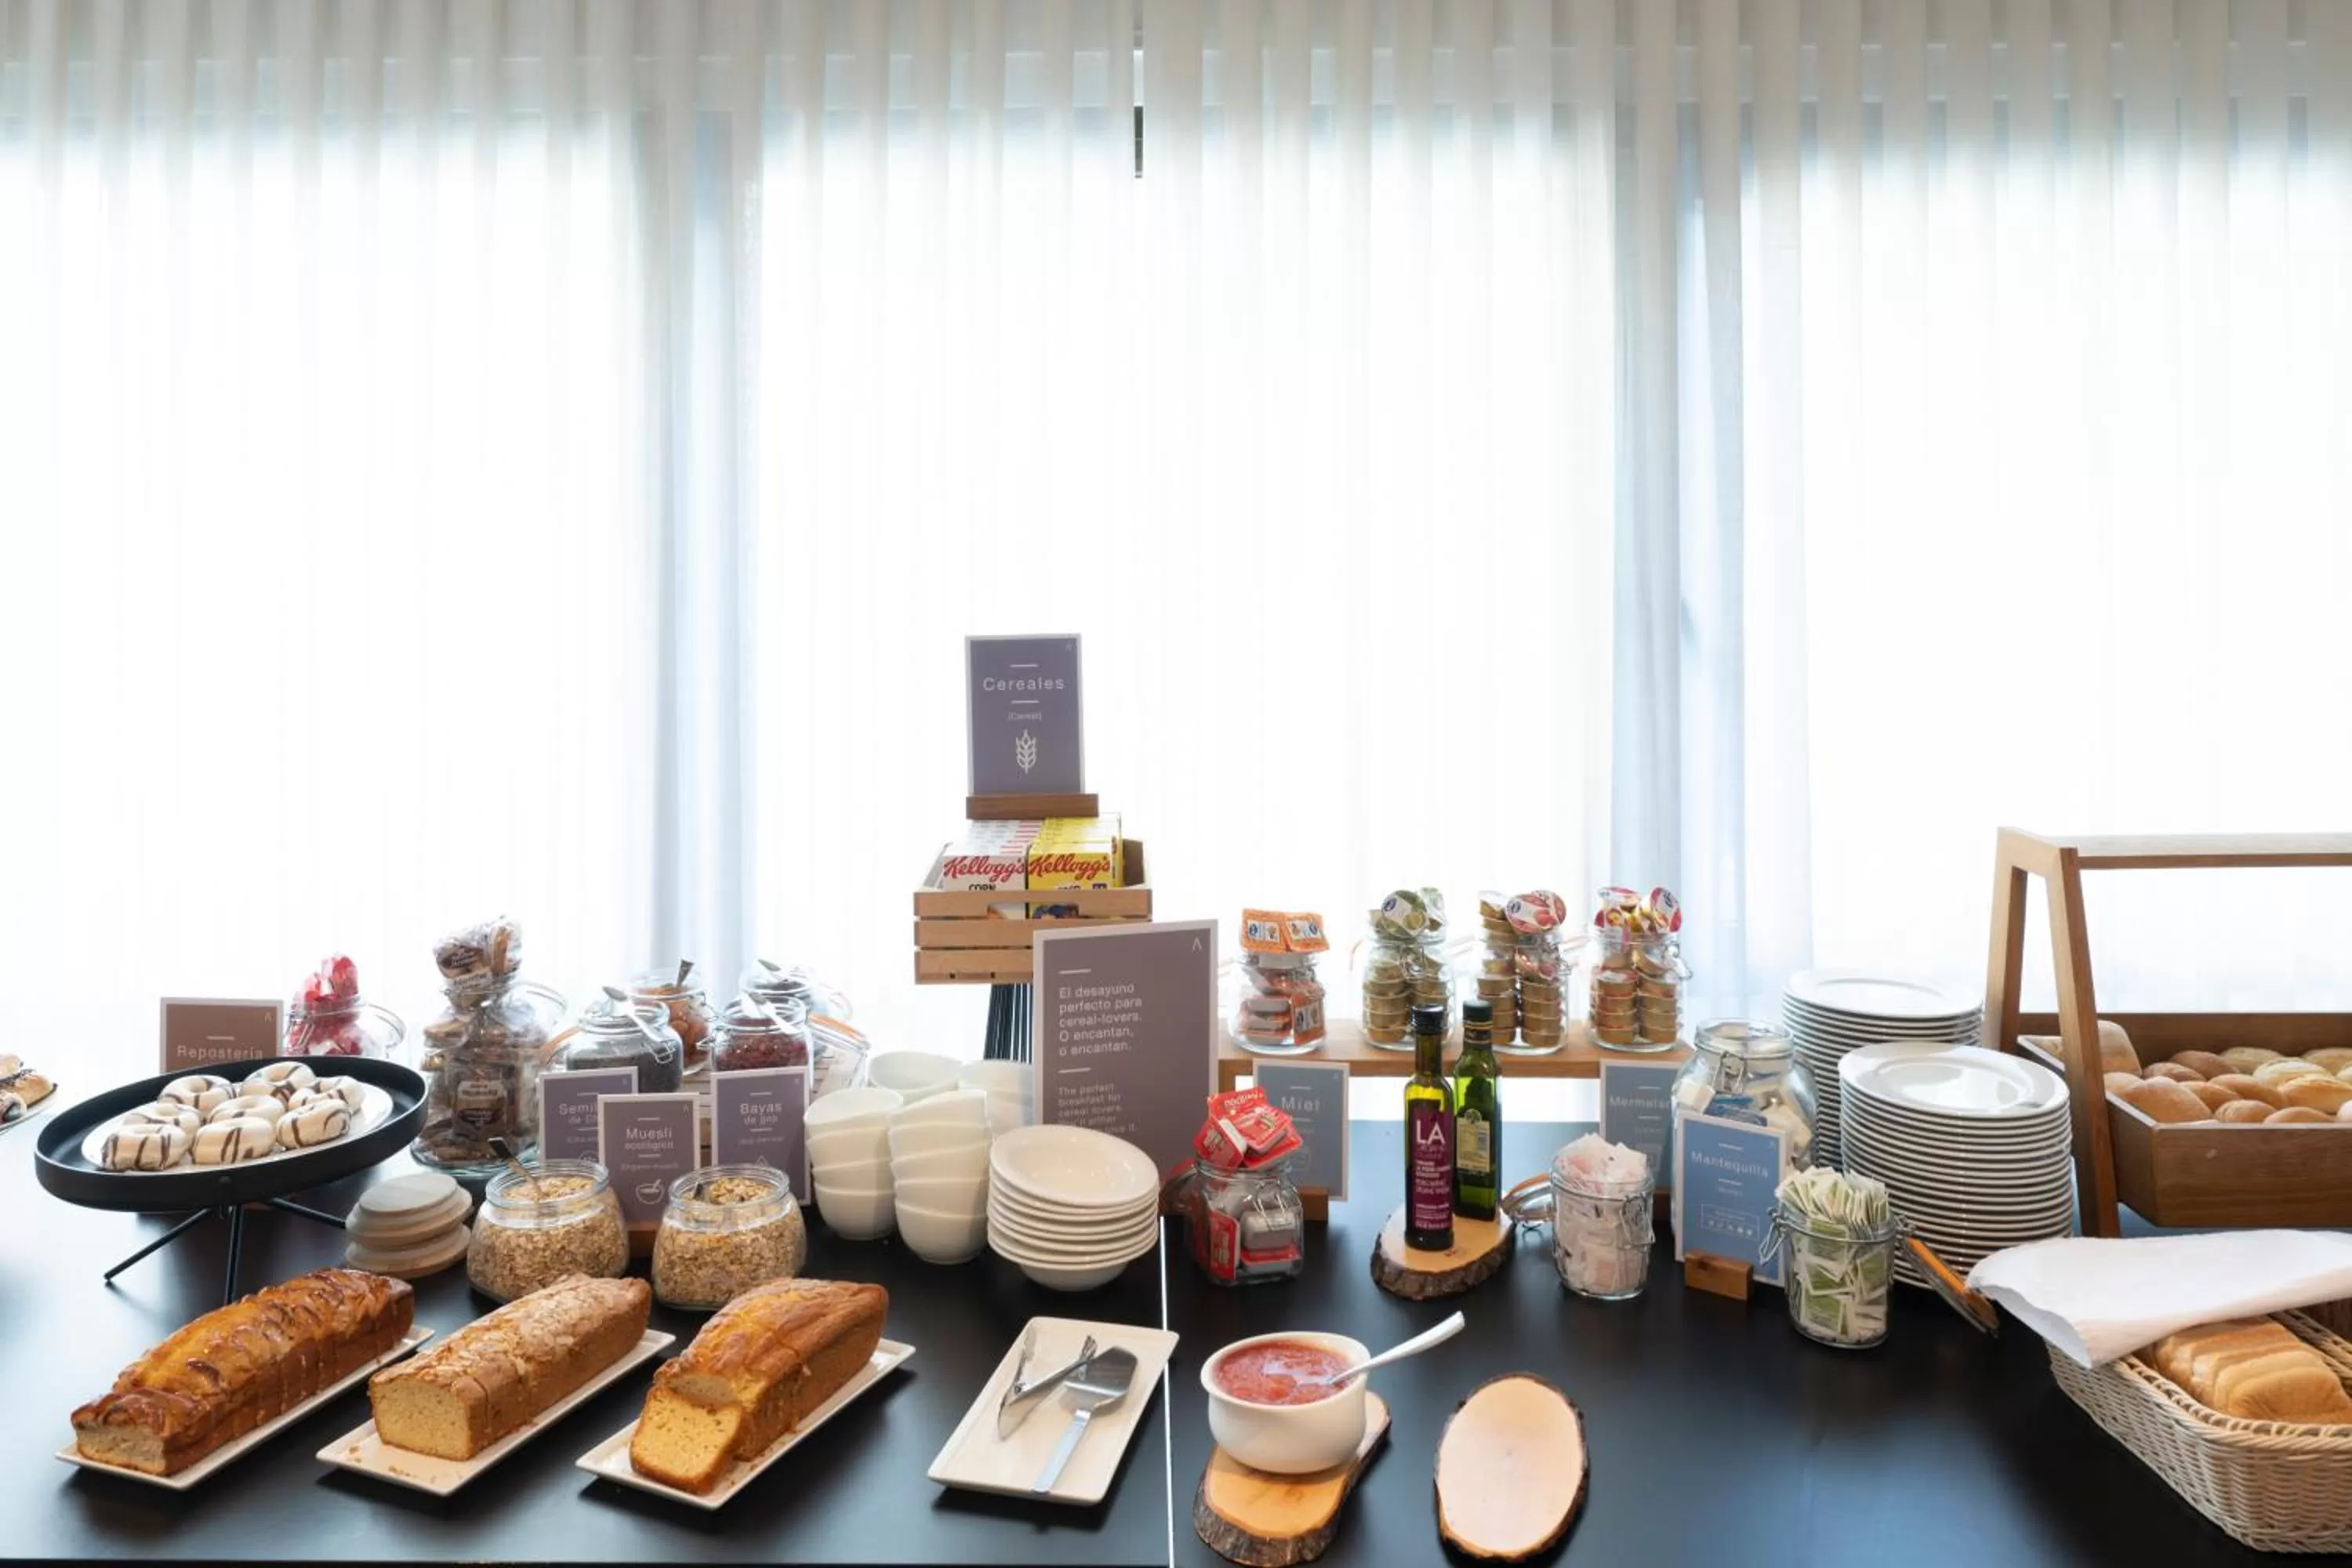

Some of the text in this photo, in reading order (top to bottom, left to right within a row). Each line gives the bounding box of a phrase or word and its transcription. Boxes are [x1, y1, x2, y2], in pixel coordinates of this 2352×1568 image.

[982, 677, 1065, 691] Cereales
[943, 855, 1025, 883] Kellogg's
[1028, 853, 1111, 880] Kellogg's
[1059, 984, 1134, 999] El desayuno
[1059, 998, 1142, 1015] perfecto para
[1059, 1029, 1069, 1042] O
[1059, 1046, 1067, 1057] o
[740, 1103, 782, 1116] Bayas
[1281, 1096, 1320, 1112] Miel
[626, 1126, 673, 1140] Muesli
[1416, 1120, 1446, 1145] LA
